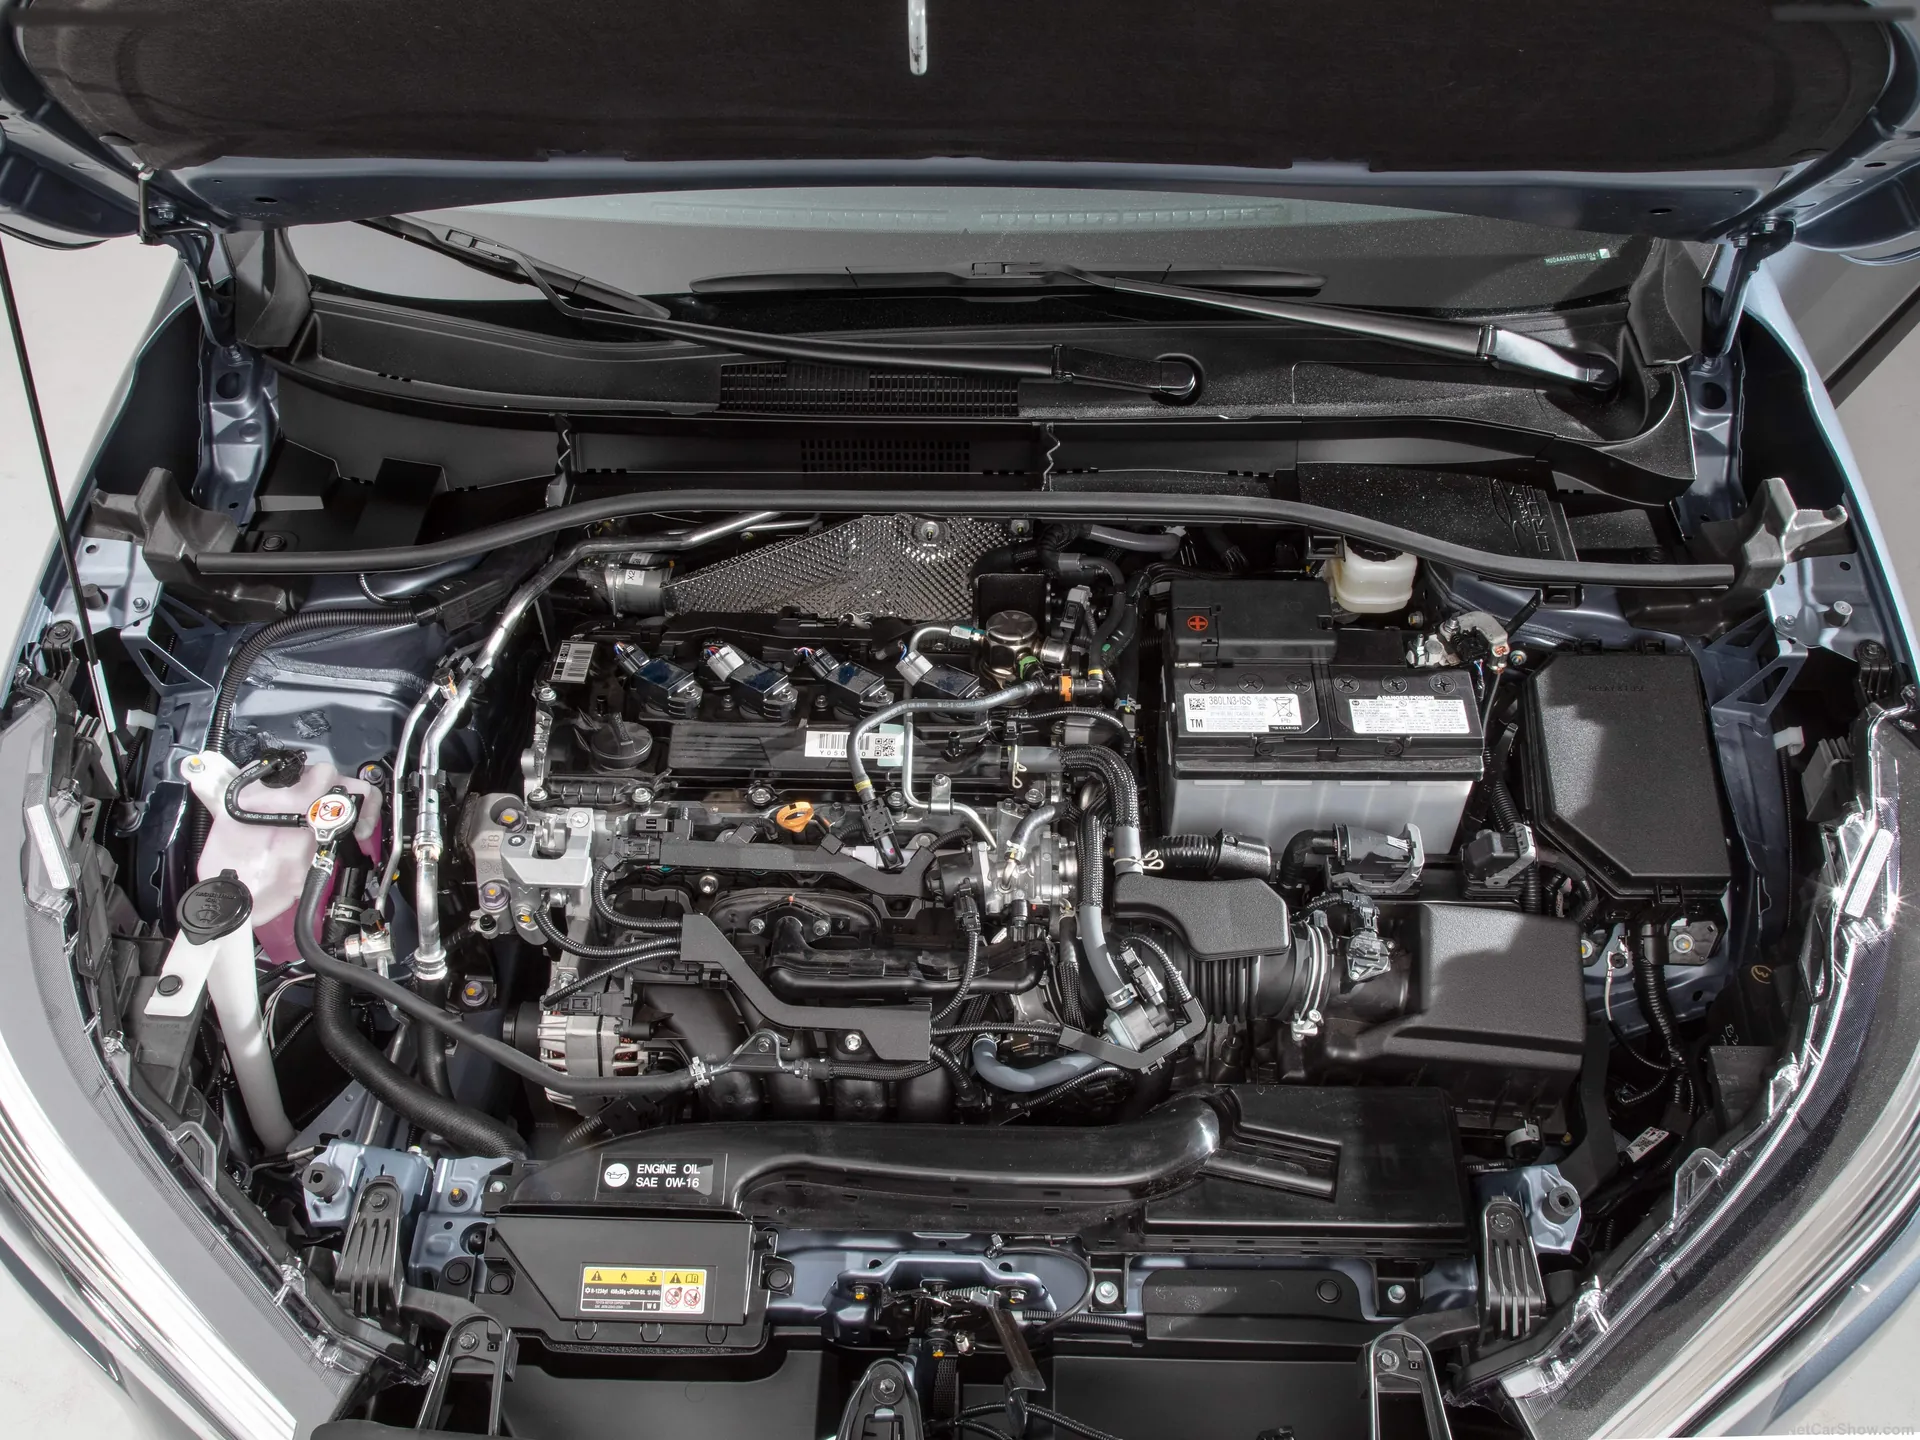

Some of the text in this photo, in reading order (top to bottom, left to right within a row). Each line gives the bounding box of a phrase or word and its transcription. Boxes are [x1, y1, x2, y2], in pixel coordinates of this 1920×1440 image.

[1208, 696, 1252, 706] 380LN3-ISS
[1190, 719, 1204, 728] TM
[637, 1163, 701, 1175] ENGINE OIL
[635, 1177, 700, 1188] SAE 0W-16
